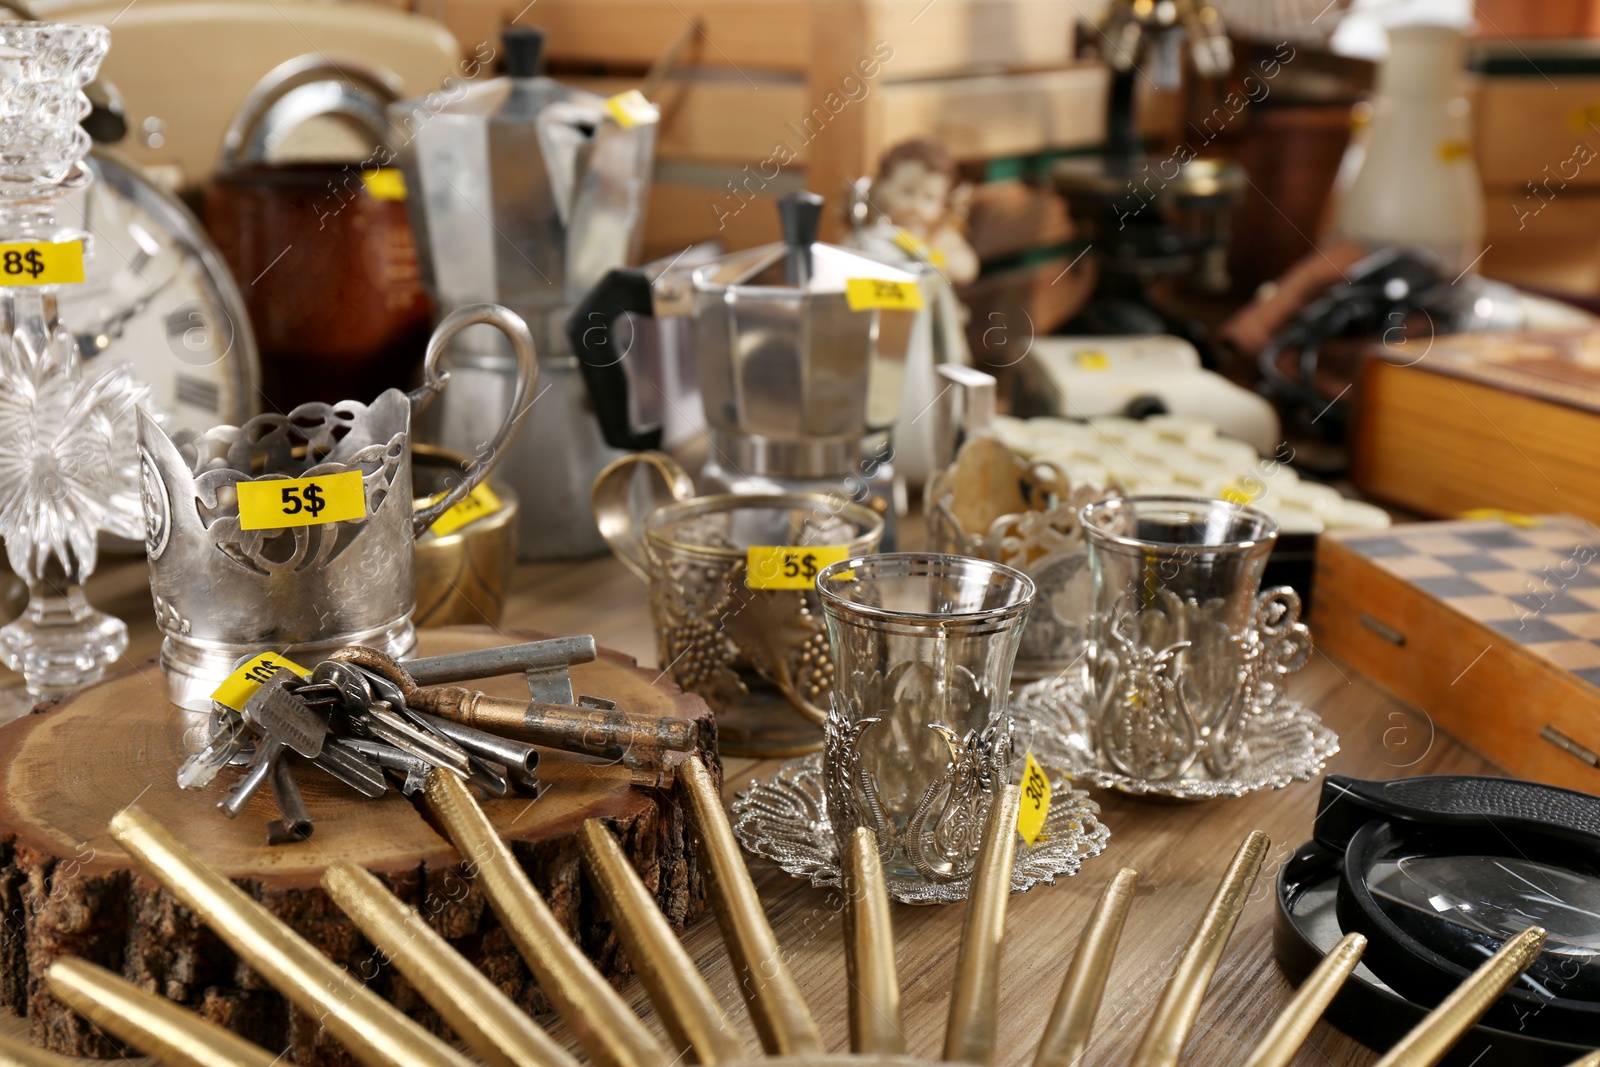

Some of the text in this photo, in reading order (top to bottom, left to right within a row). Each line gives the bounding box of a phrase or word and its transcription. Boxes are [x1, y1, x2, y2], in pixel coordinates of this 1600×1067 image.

[3, 247, 45, 279] 8$
[281, 483, 326, 517] 5$
[784, 552, 818, 581] 5$
